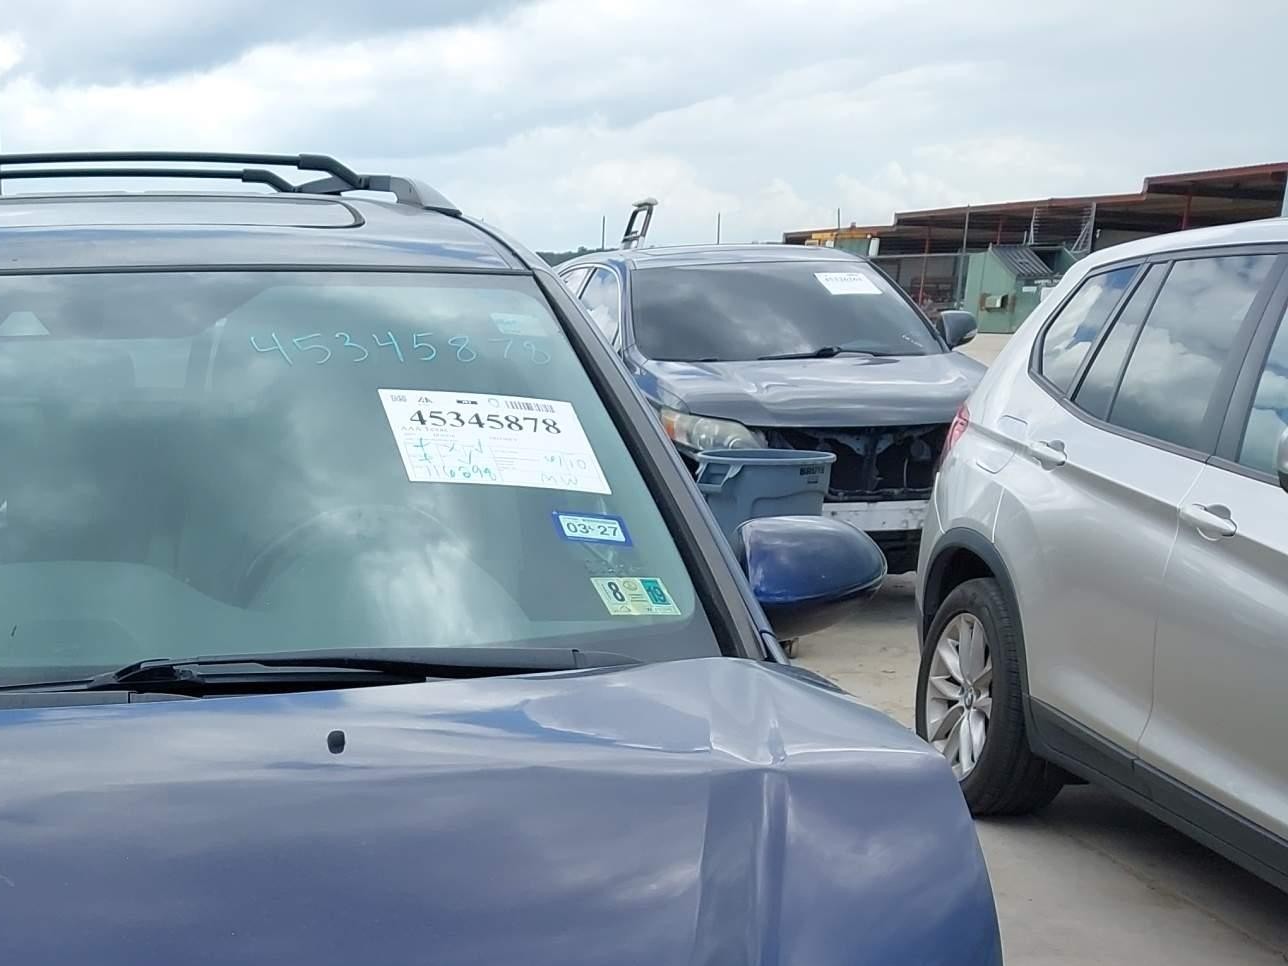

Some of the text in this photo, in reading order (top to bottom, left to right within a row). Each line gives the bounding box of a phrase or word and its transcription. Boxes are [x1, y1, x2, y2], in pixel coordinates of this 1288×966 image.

[250, 331, 552, 366] 45345878
[409, 409, 562, 435] 45345878
[566, 522, 618, 536] 03 27
[607, 581, 667, 603] 8 19
